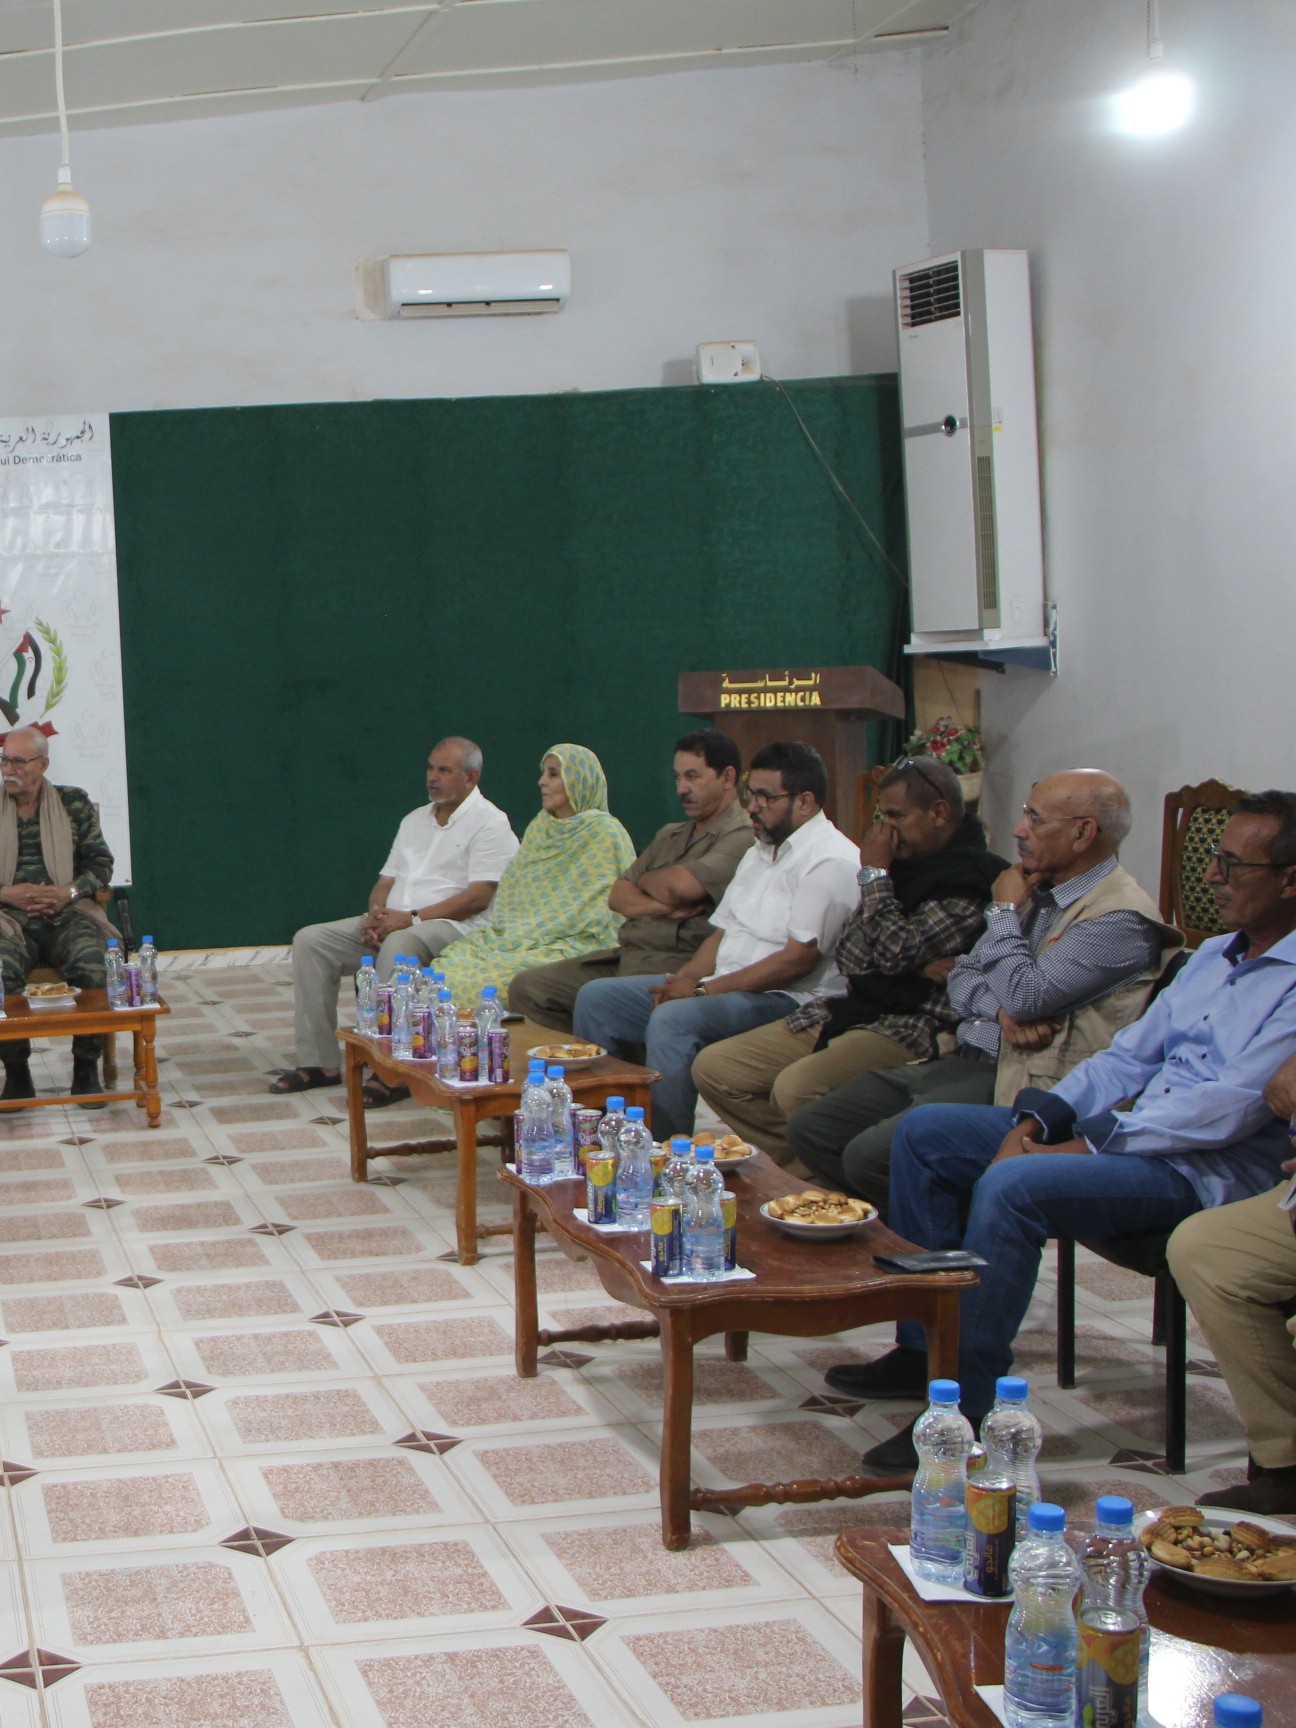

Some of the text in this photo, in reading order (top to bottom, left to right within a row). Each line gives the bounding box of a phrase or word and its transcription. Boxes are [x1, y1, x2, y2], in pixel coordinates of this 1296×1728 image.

[40, 419, 94, 450] الجمهورية
[721, 670, 820, 689] الرئاسة
[721, 691, 821, 707] PRESIDENCIA
